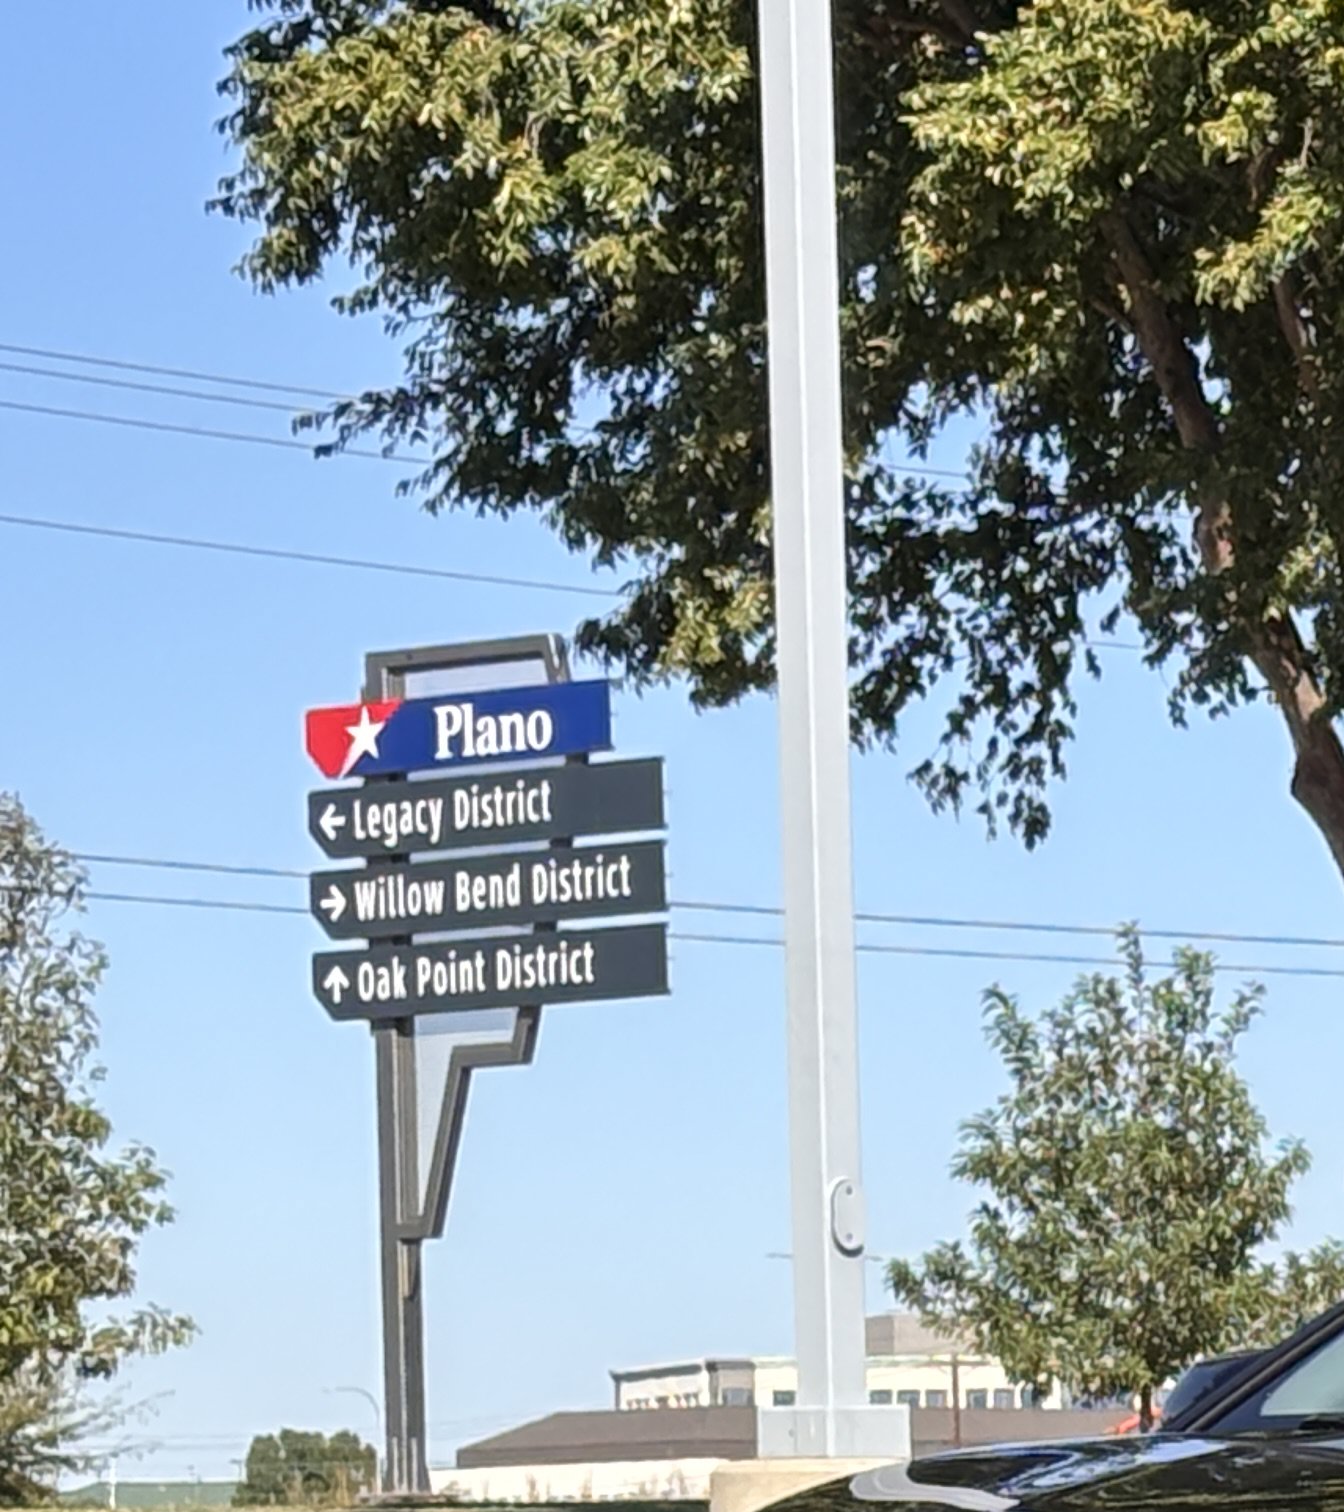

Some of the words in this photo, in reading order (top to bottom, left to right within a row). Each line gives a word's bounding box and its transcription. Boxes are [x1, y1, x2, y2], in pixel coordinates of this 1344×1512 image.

[433, 703, 553, 760] Plano
[353, 797, 444, 847] Legacy
[453, 779, 552, 832] District
[354, 873, 445, 921] Willow
[456, 863, 521, 913] Bend
[531, 854, 632, 905] District
[357, 957, 407, 1002] Oak
[416, 950, 486, 997] Point
[496, 941, 595, 994] District
